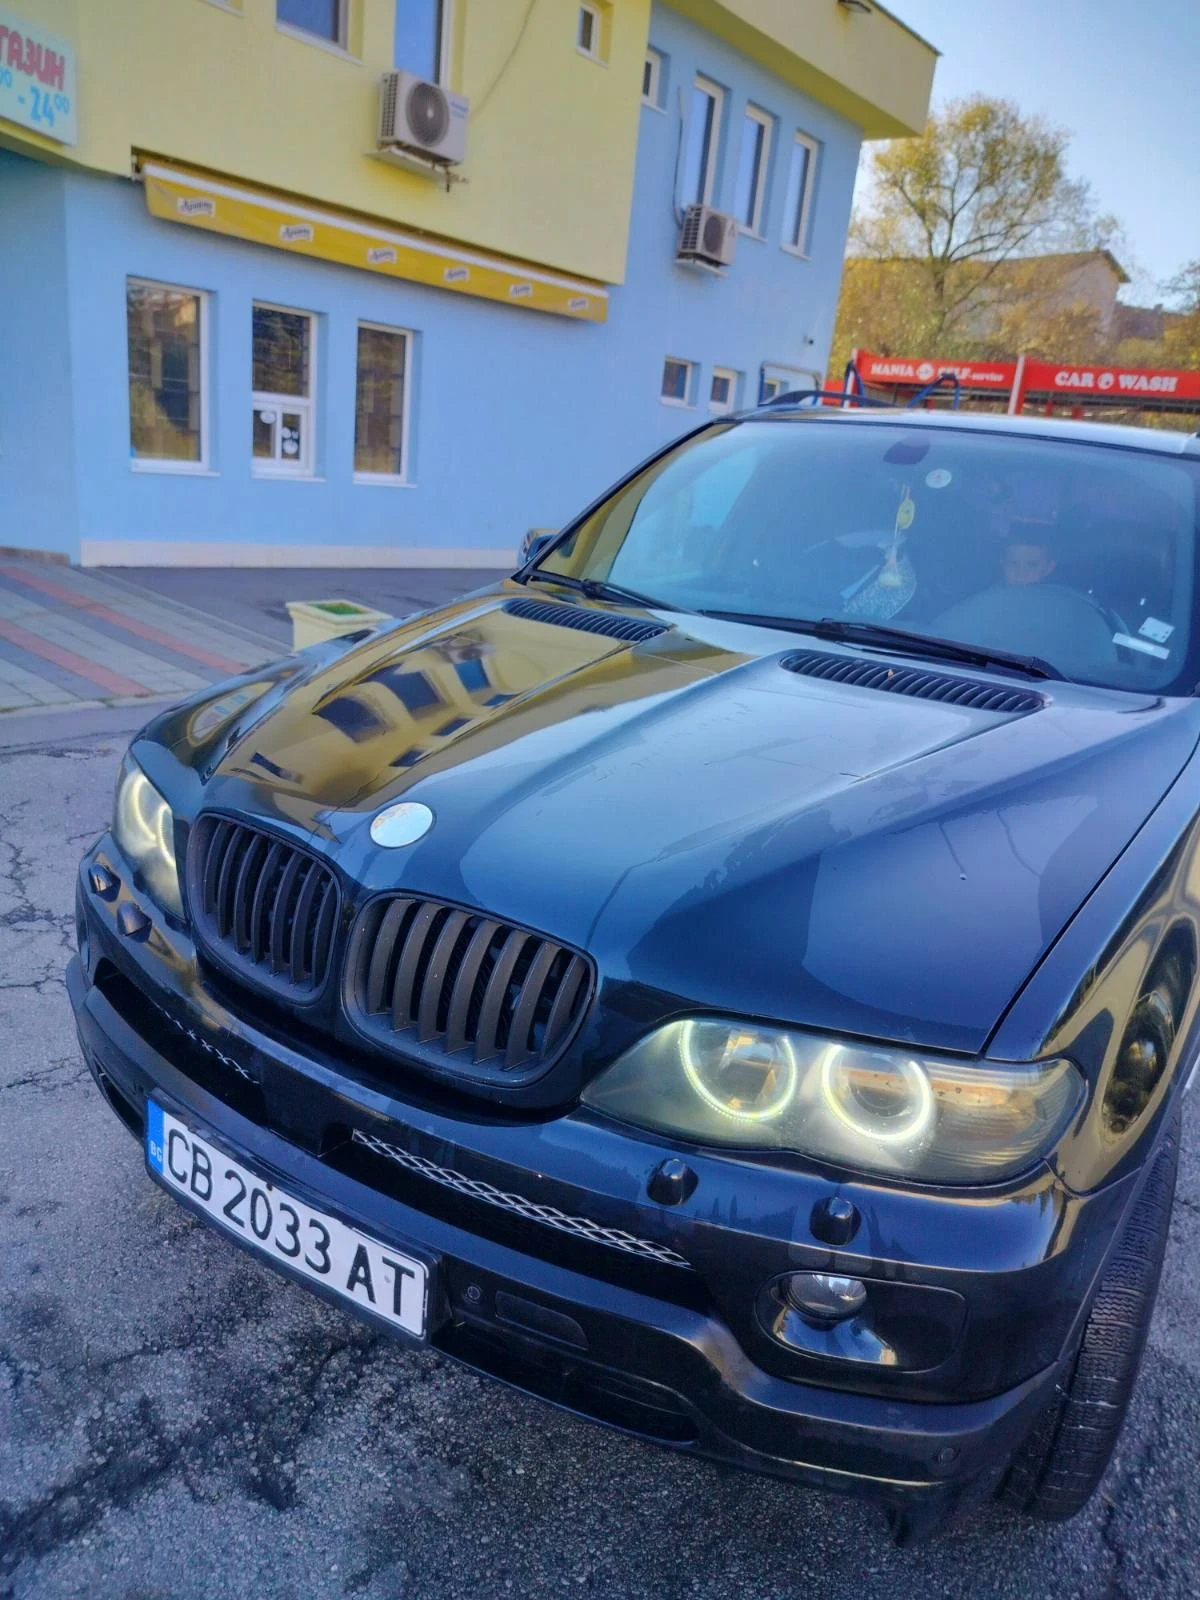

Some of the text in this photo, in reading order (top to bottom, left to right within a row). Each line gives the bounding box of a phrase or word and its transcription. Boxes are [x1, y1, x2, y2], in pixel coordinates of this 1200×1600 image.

[870, 362, 914, 377] MANIA
[1055, 371, 1178, 393] CAR WASH
[150, 1140, 163, 1163] BG
[168, 1128, 415, 1317] CB 2033 AT
